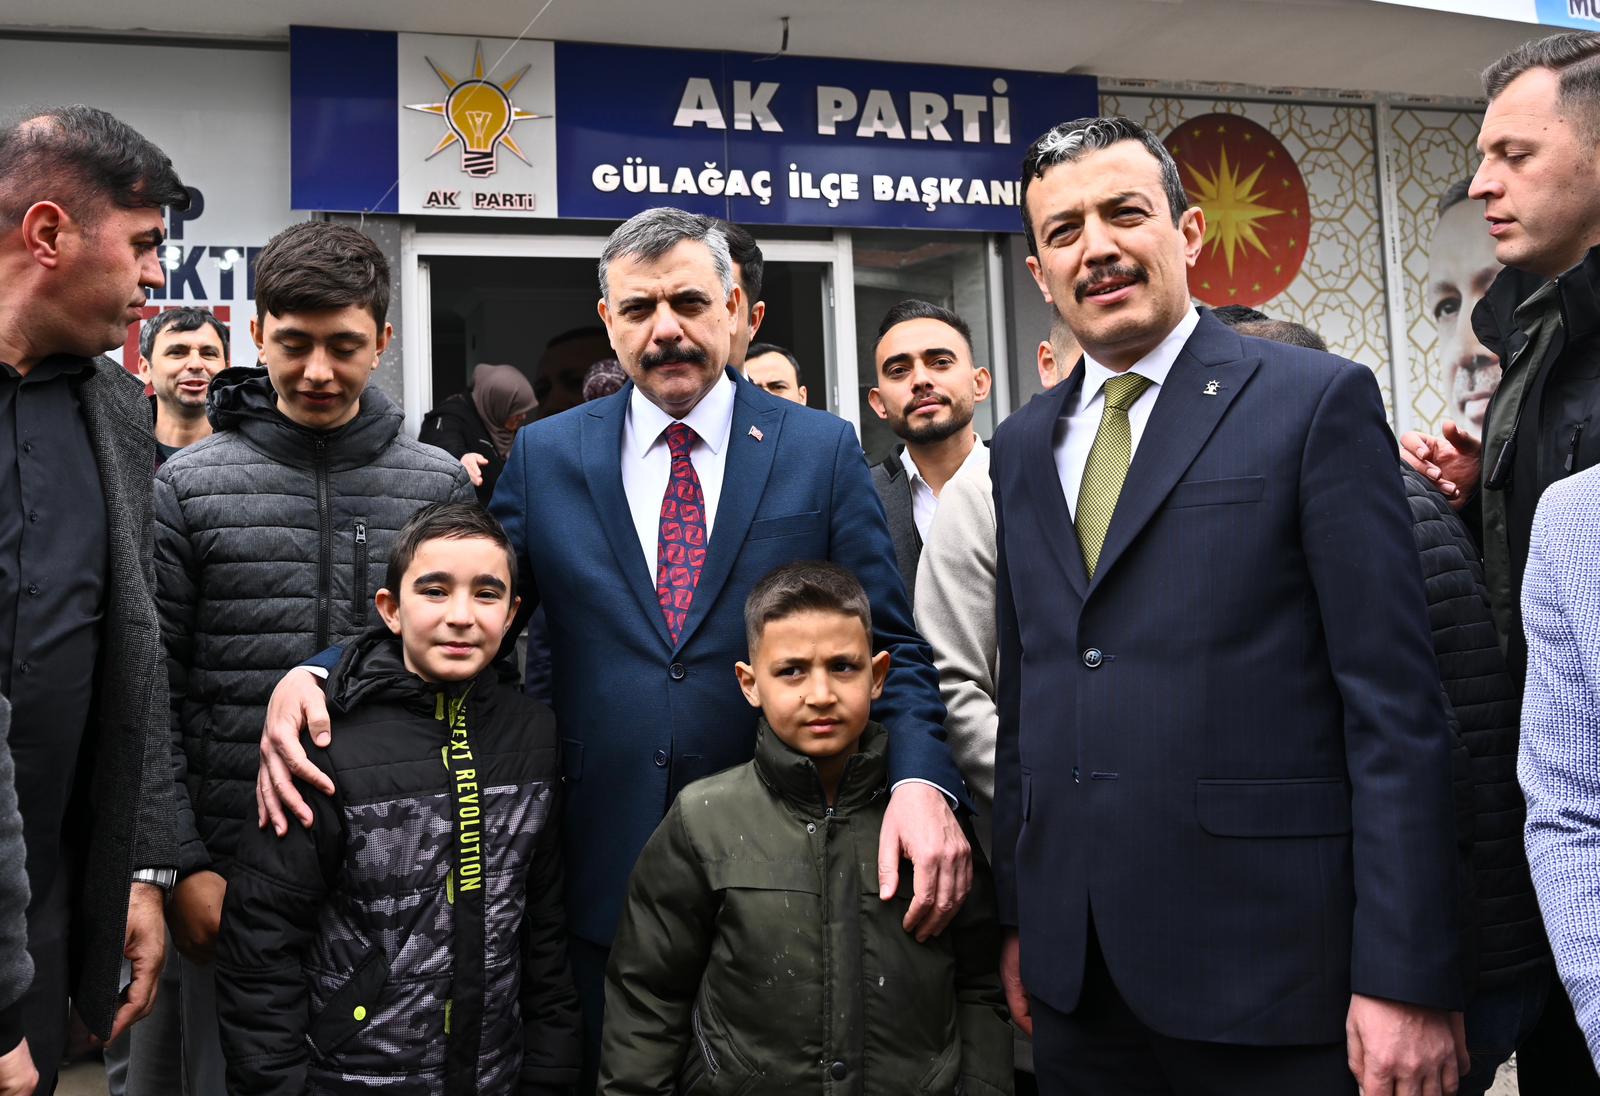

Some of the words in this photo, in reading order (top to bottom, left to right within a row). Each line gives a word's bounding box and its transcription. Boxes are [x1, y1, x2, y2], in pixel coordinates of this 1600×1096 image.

[673, 77, 784, 132] AK
[817, 78, 1011, 144] PARTİ
[425, 190, 458, 207] AK
[592, 157, 772, 205] GÜLAĞAÇ
[789, 163, 859, 208] İLÇE
[873, 175, 1021, 212] BAŞKAN
[456, 768, 482, 892] REVOLUTION
